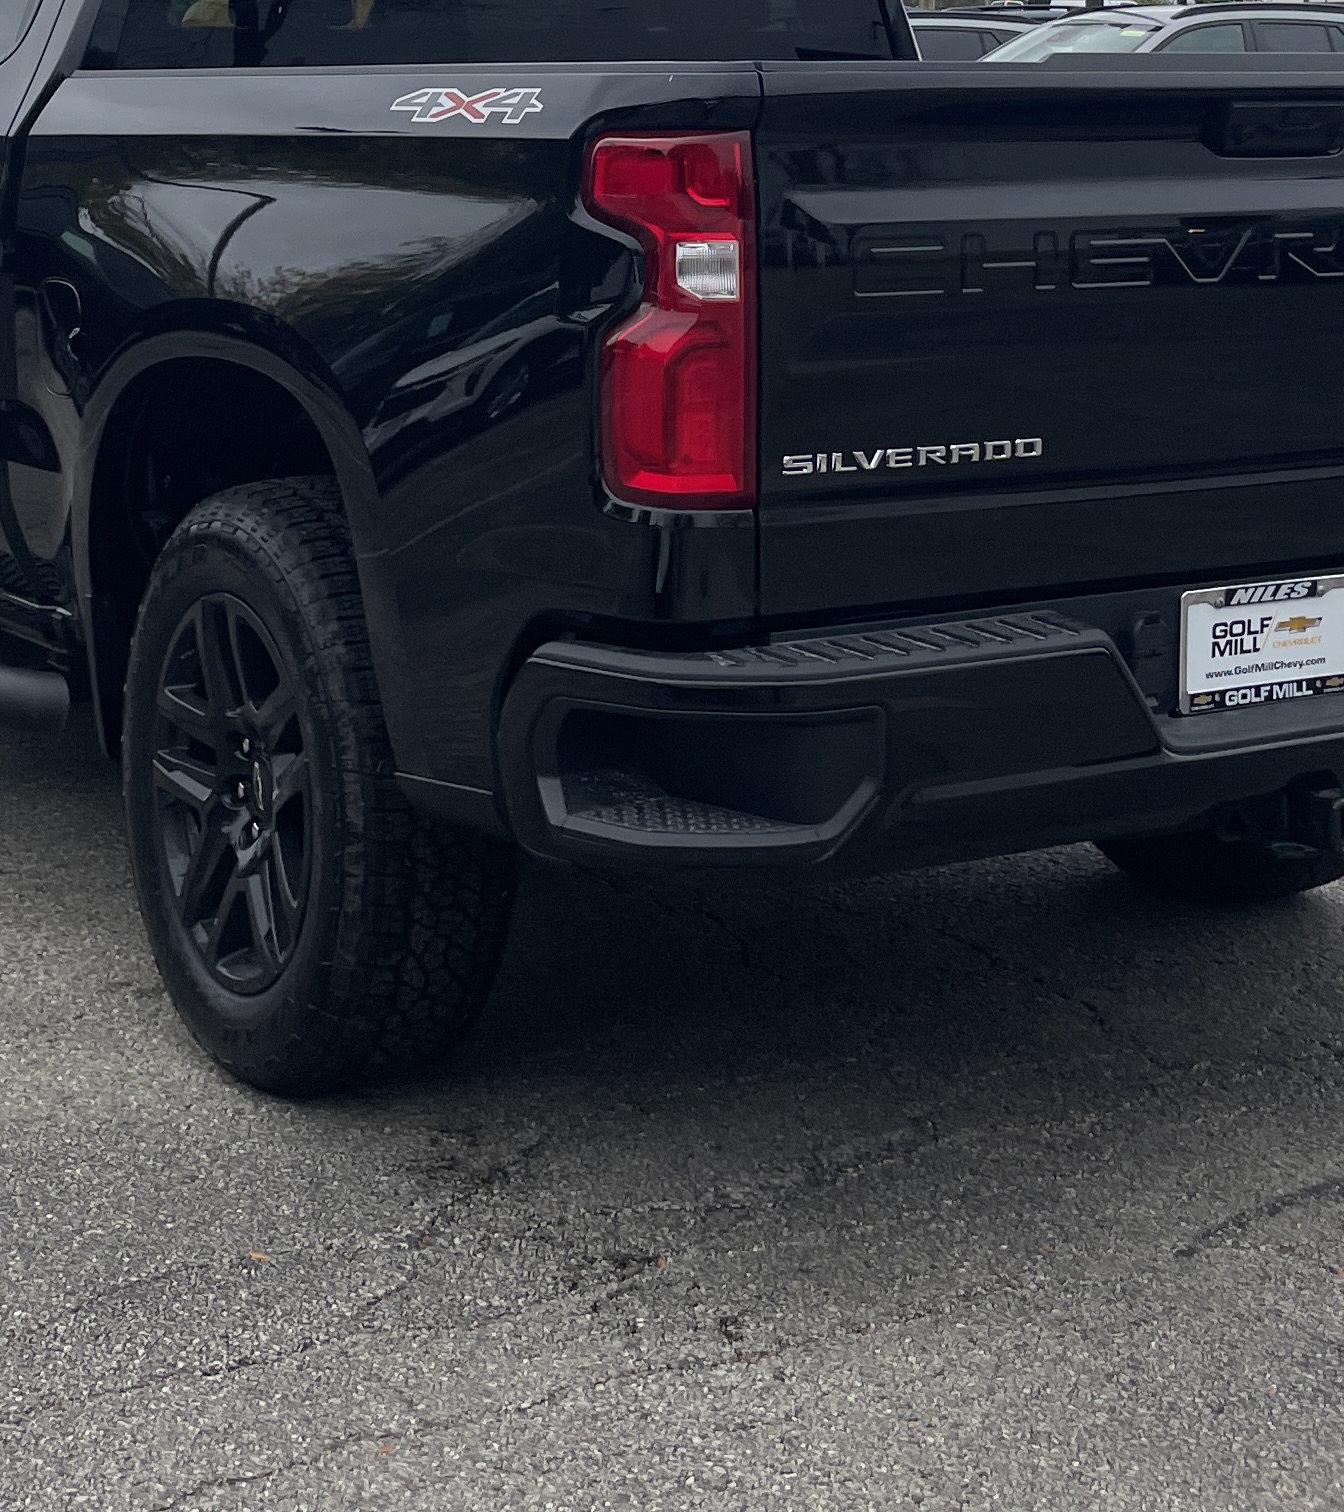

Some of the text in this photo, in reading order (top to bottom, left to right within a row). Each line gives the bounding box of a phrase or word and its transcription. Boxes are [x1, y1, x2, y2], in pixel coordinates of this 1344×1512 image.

[782, 437, 1043, 476] SILVERADO
[1230, 581, 1312, 605] NILES
[1212, 616, 1273, 640] GOLF
[1211, 637, 1261, 659] MILL
[1205, 656, 1326, 680] www.GolfMillChevy.com
[1225, 680, 1314, 707] GOLF MILL
